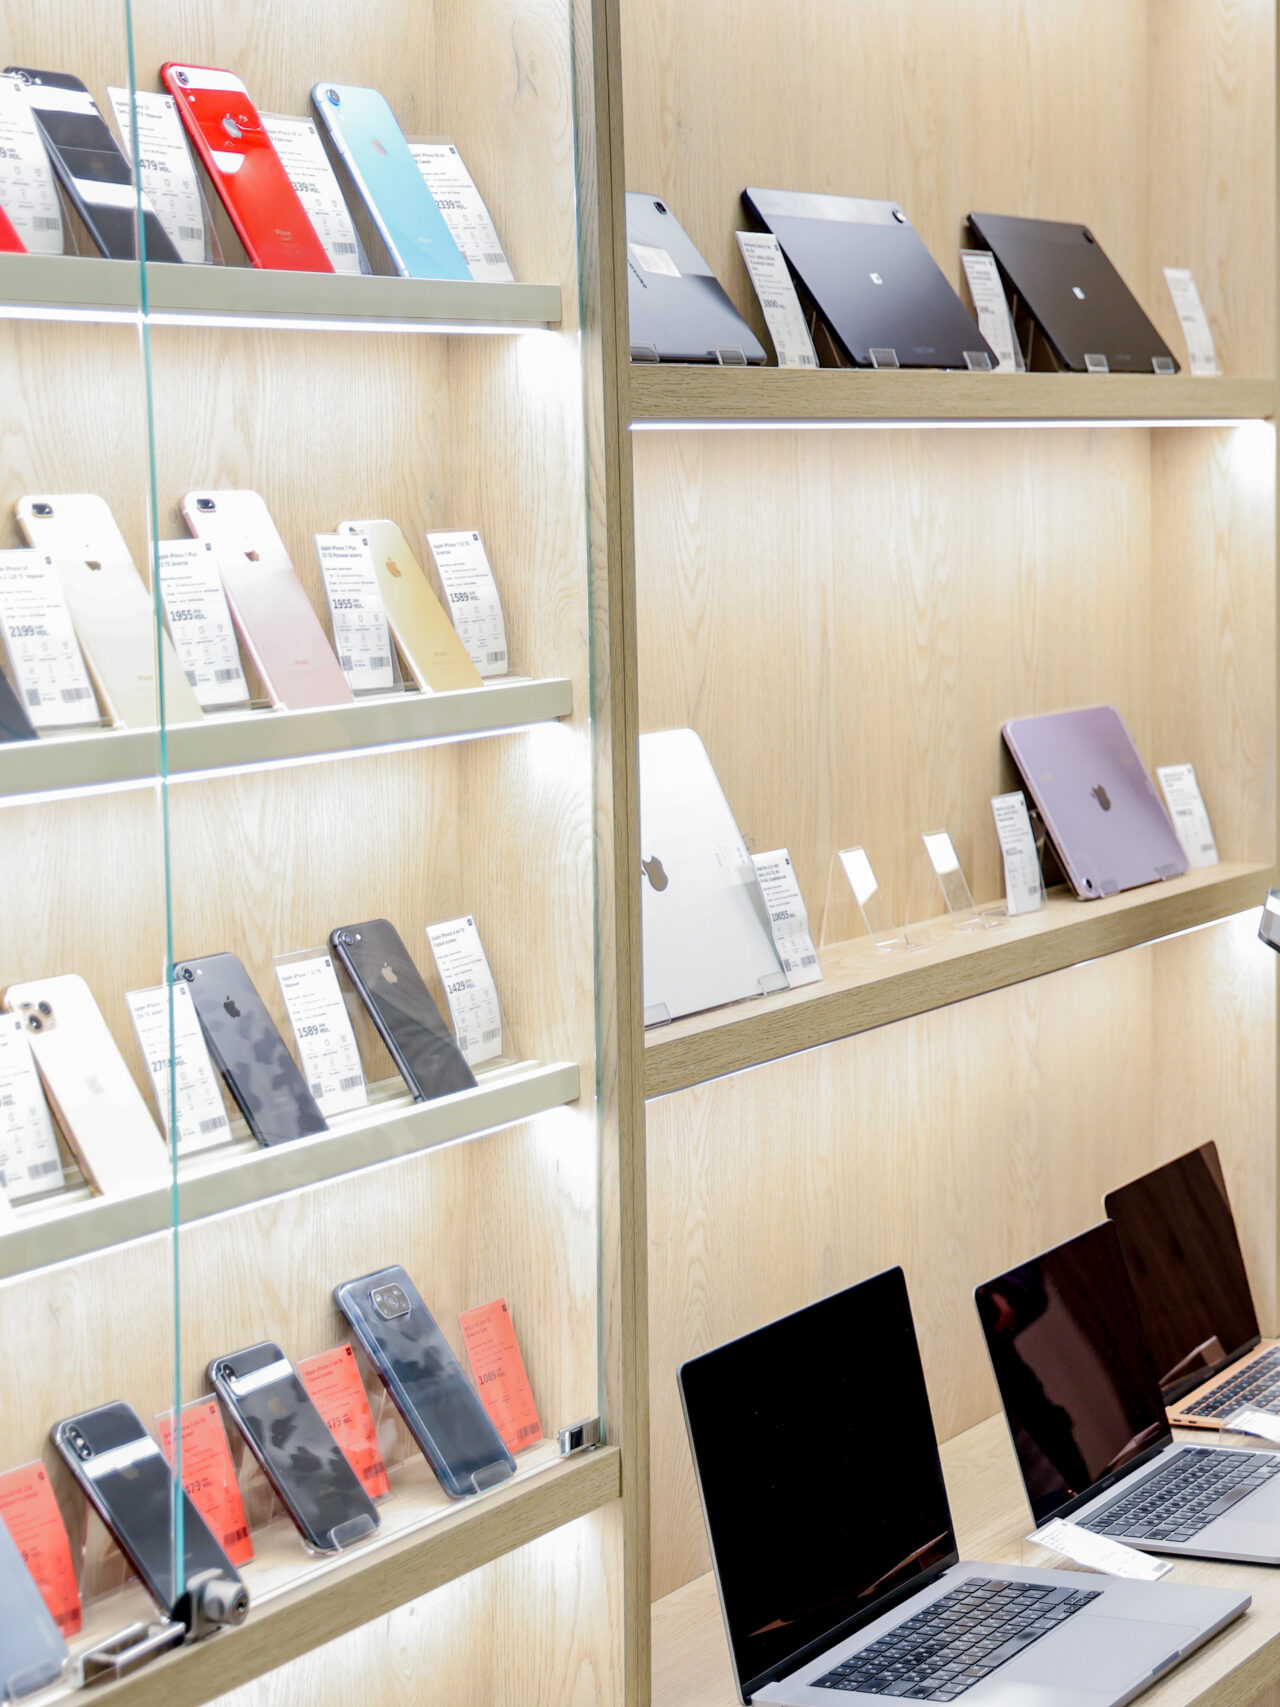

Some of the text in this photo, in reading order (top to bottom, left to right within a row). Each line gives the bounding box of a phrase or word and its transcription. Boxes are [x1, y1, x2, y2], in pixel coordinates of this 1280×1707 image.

[332, 598, 353, 609] 1955
[449, 592, 469, 603] 1589
[170, 610, 193, 622] 1955
[8, 625, 35, 638] 2199
[447, 981, 466, 994] 1429
[297, 1025, 319, 1039] 1589
